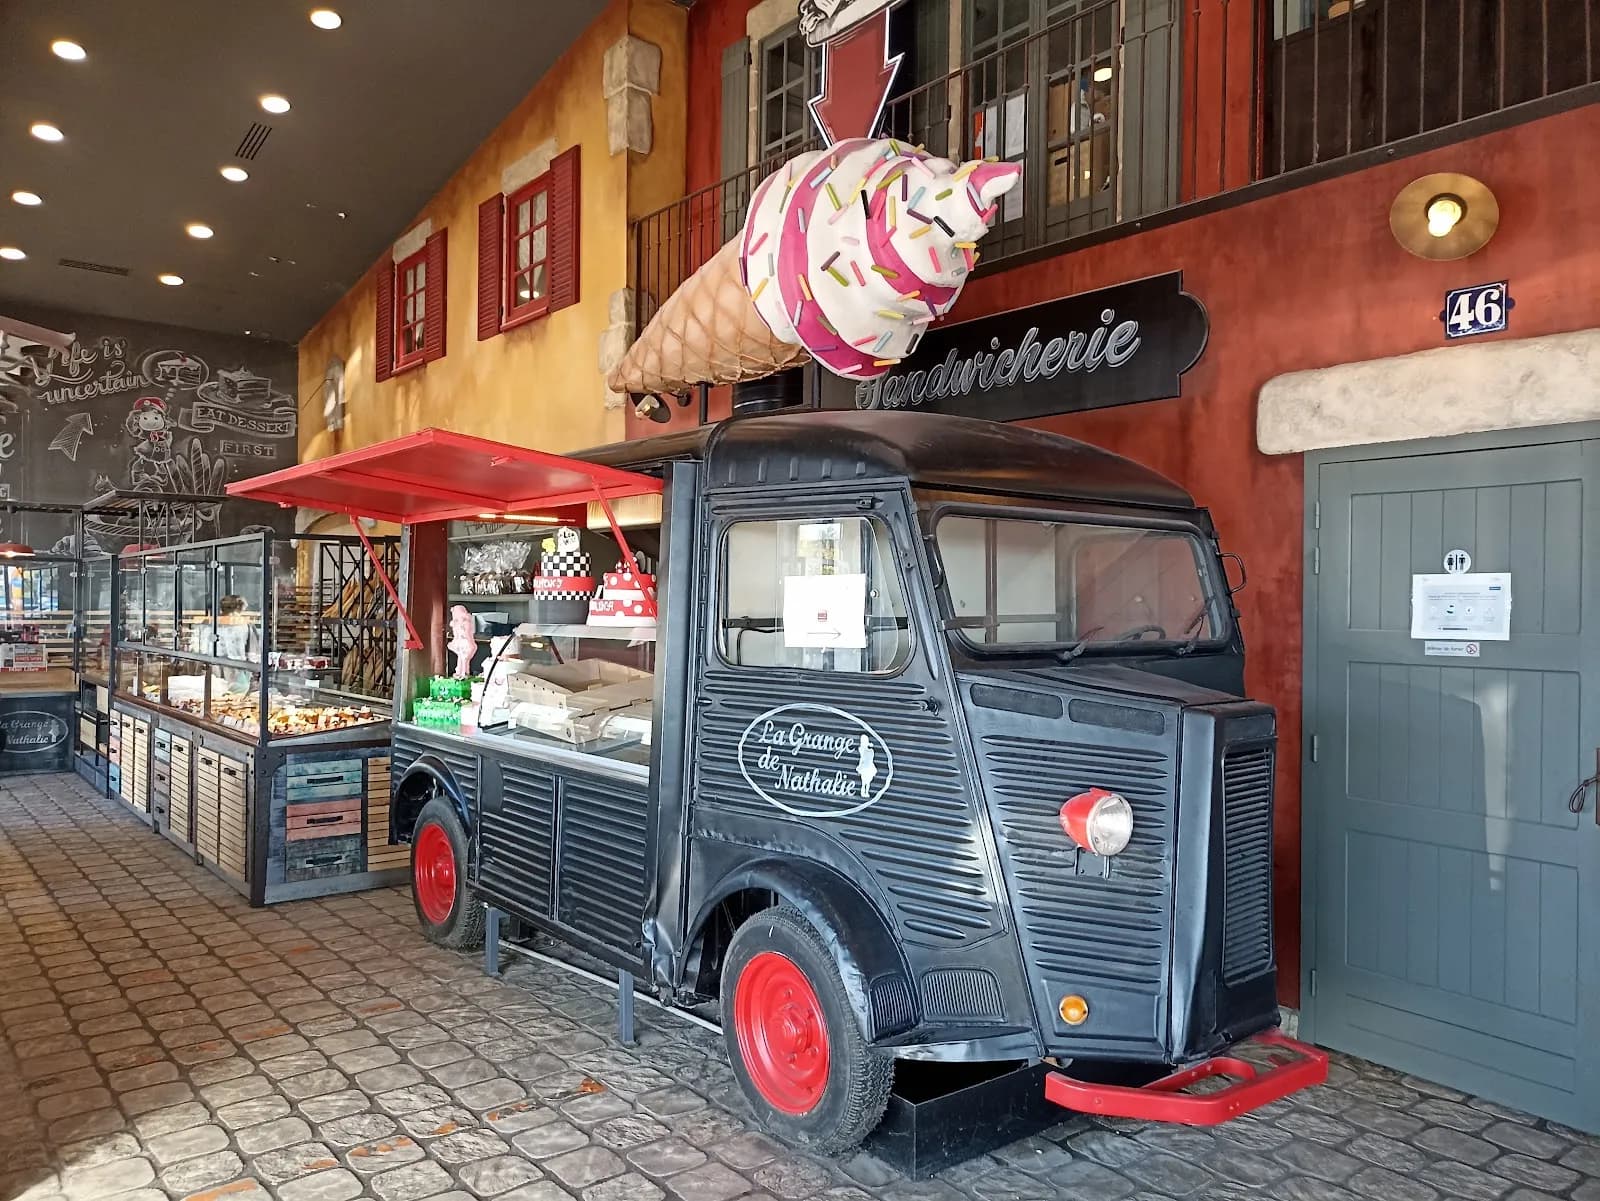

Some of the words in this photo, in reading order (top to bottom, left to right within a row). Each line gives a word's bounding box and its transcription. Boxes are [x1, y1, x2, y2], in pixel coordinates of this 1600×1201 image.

[1449, 288, 1501, 331] 46
[103, 339, 126, 359] is
[37, 360, 151, 404] uncertain
[197, 407, 225, 421] EAT
[227, 413, 291, 433] DESSERT
[223, 442, 274, 456] FIRST
[11, 719, 49, 731] Grange
[759, 720, 787, 746] La
[788, 722, 856, 760] Grange
[757, 745, 780, 771] de
[774, 763, 857, 797] Nathalie
